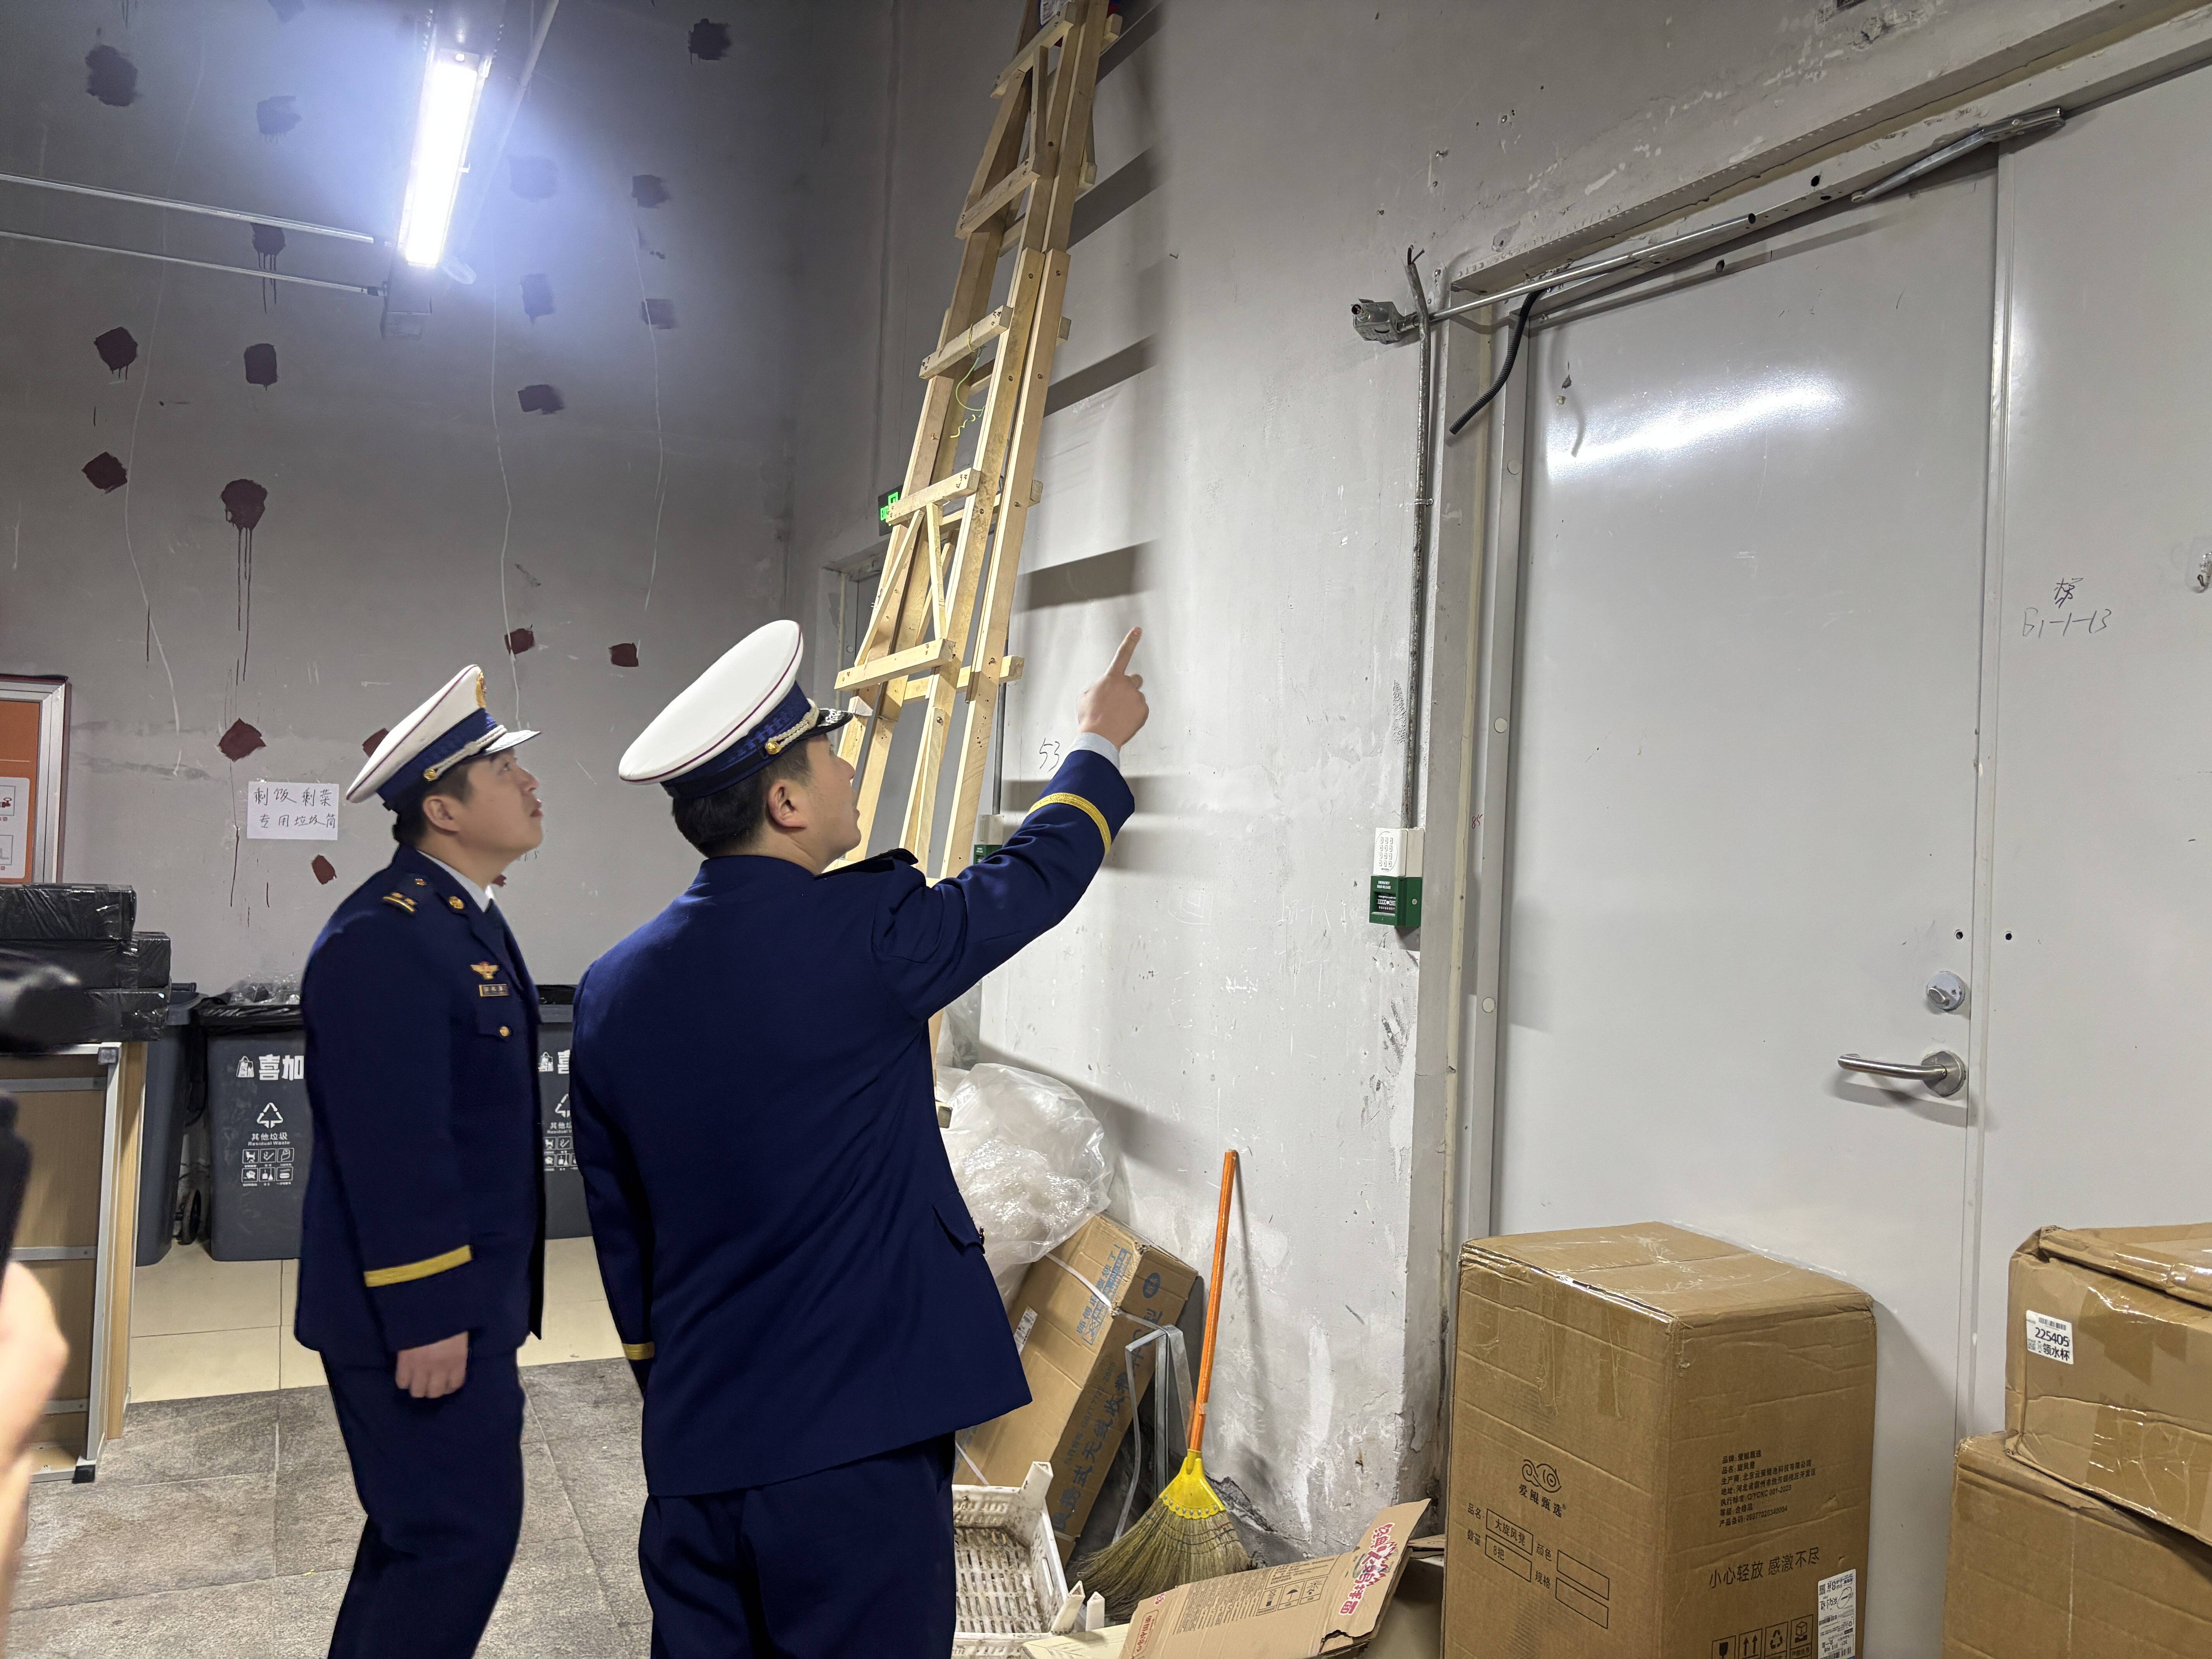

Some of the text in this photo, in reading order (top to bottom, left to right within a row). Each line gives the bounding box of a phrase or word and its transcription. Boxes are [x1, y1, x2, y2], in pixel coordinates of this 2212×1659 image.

[1039, 737, 1060, 773] 53
[251, 1132, 288, 1141] 其他垃圾
[2035, 1327, 2069, 1347] 225405
[1468, 1503, 1526, 1546] 品名 大旋风凳
[1536, 1543, 1552, 1562] 颜色
[1709, 1547, 1820, 1589] 小心轻放 感激不尽
[1535, 1571, 1551, 1589] 规格
